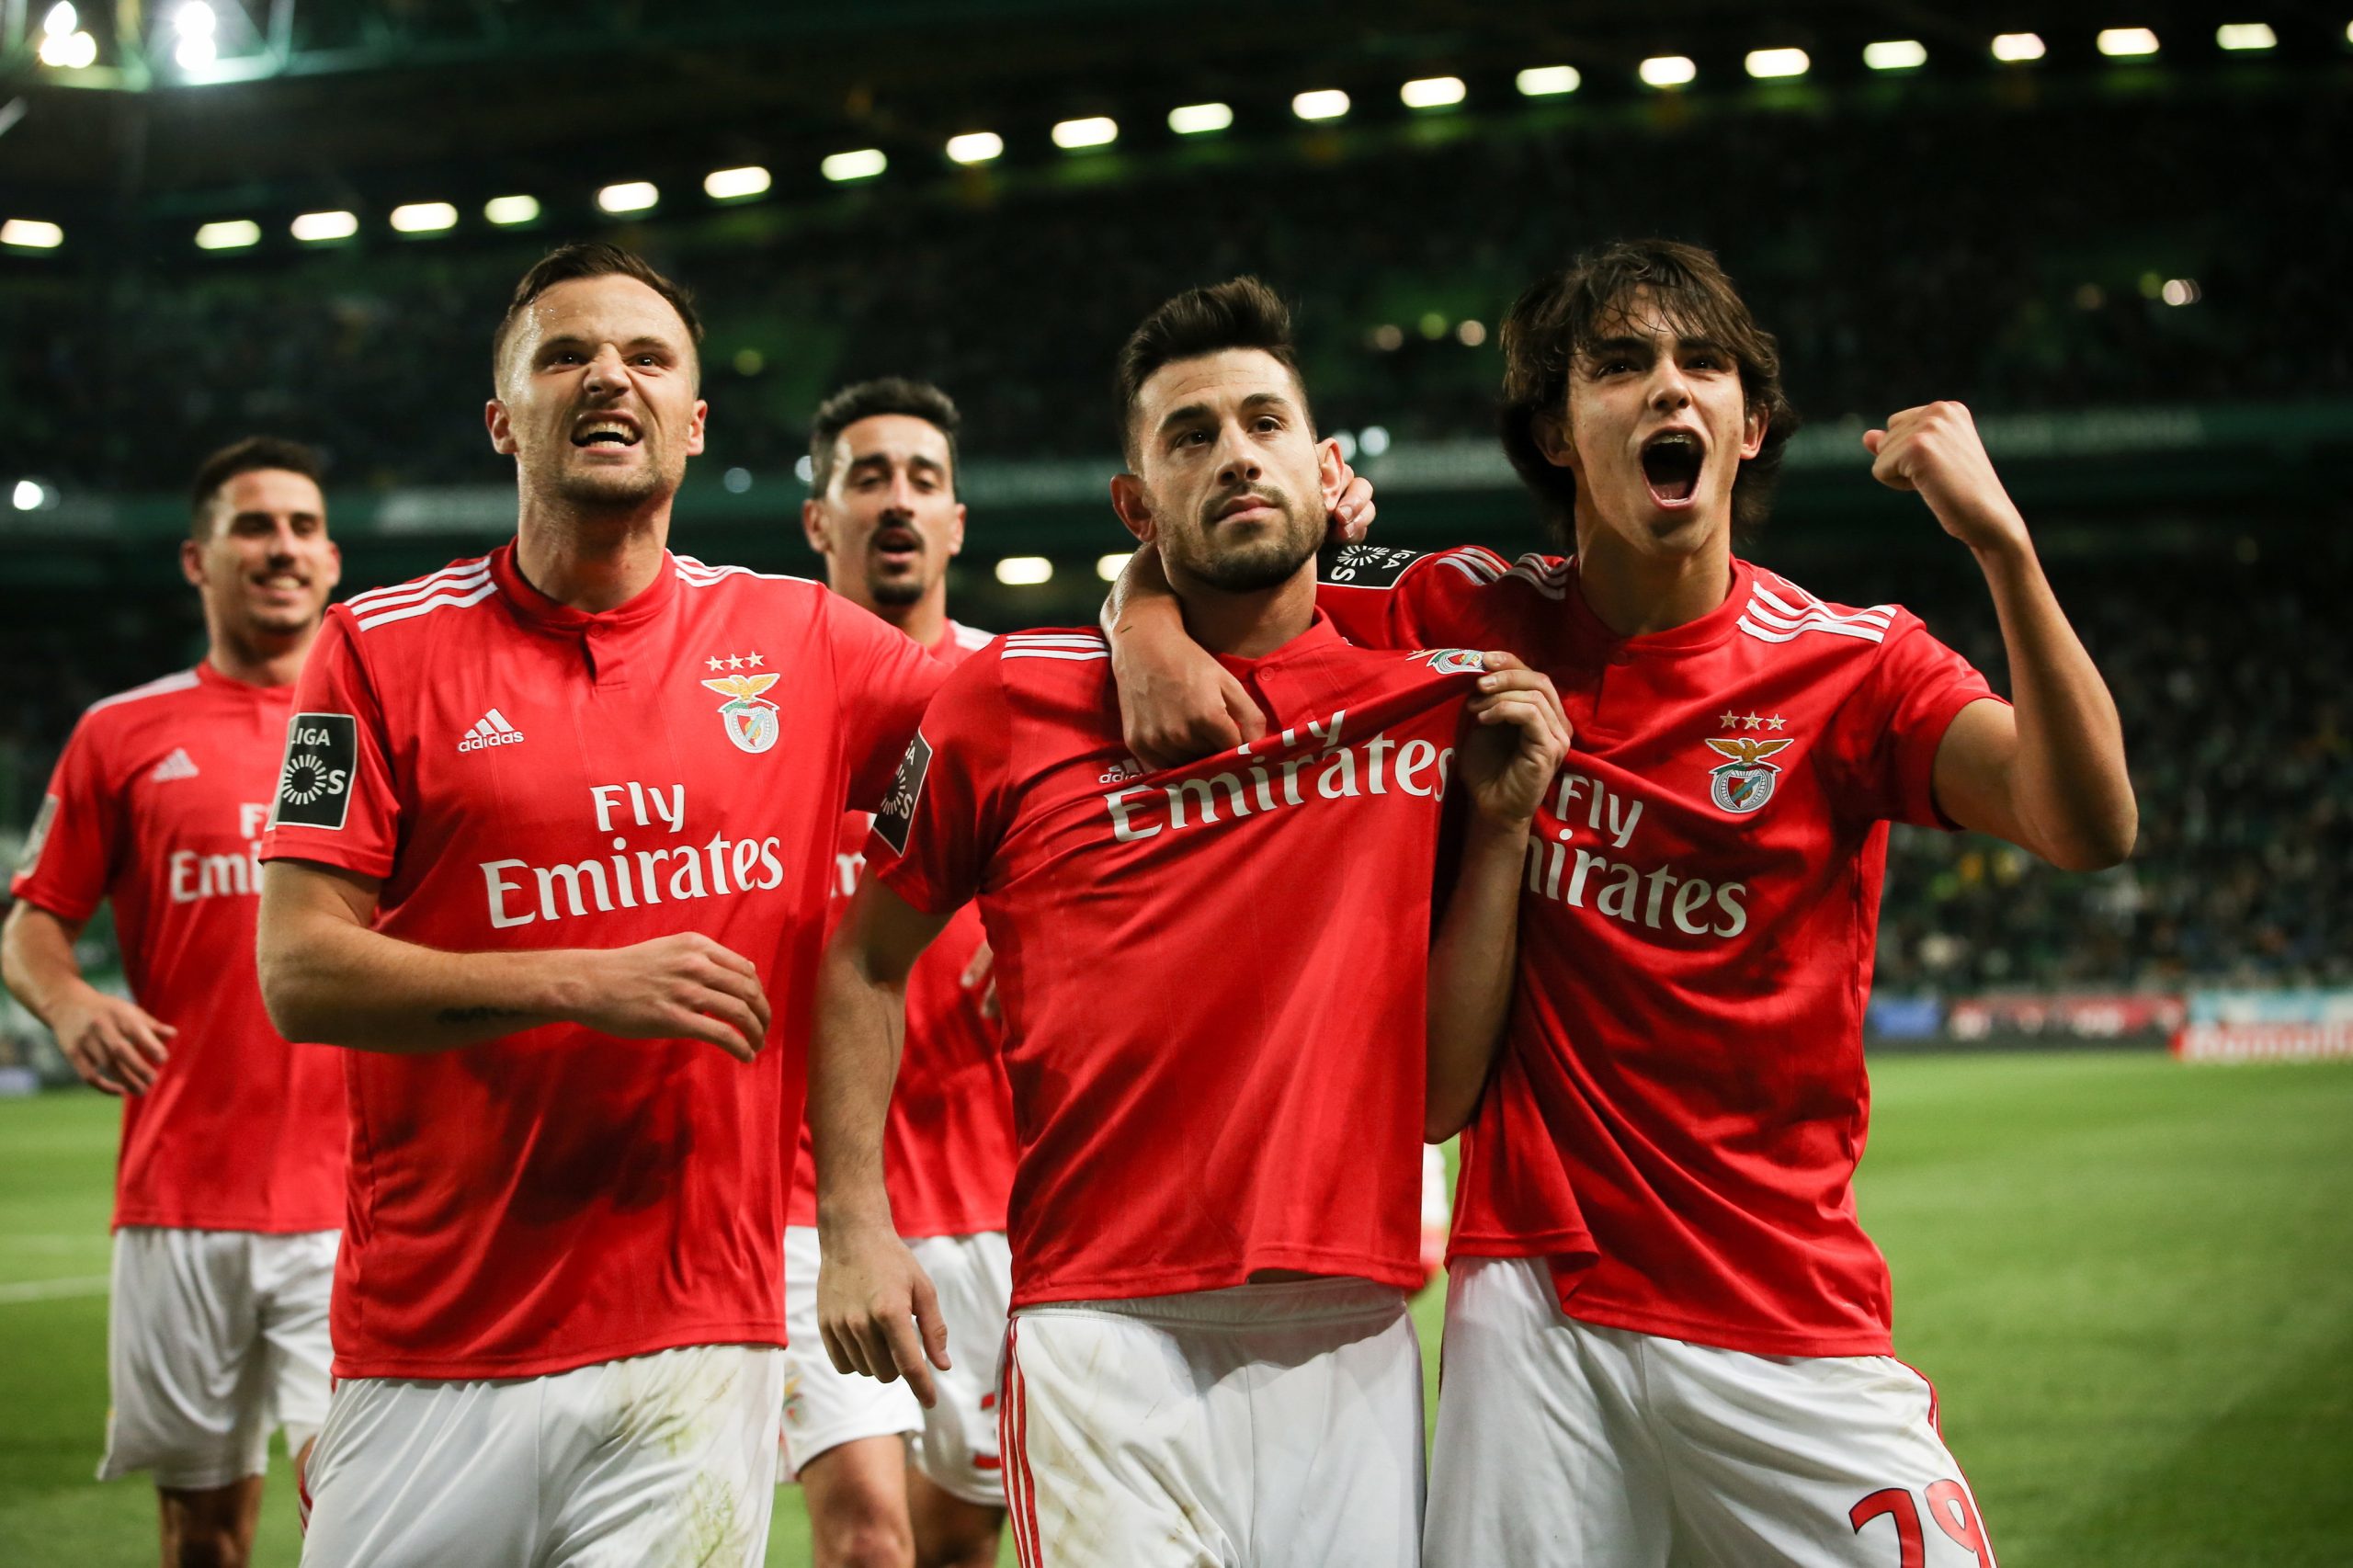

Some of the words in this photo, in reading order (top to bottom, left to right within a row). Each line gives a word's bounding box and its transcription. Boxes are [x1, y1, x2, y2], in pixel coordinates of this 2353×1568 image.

[1381, 549, 1417, 570] IGA
[458, 730, 525, 753] adidas
[590, 780, 686, 834] Fly
[1103, 731, 1457, 845] Emirates
[1555, 772, 1644, 849] Fly
[479, 831, 786, 929] Emirates
[1525, 828, 1747, 938] irates
